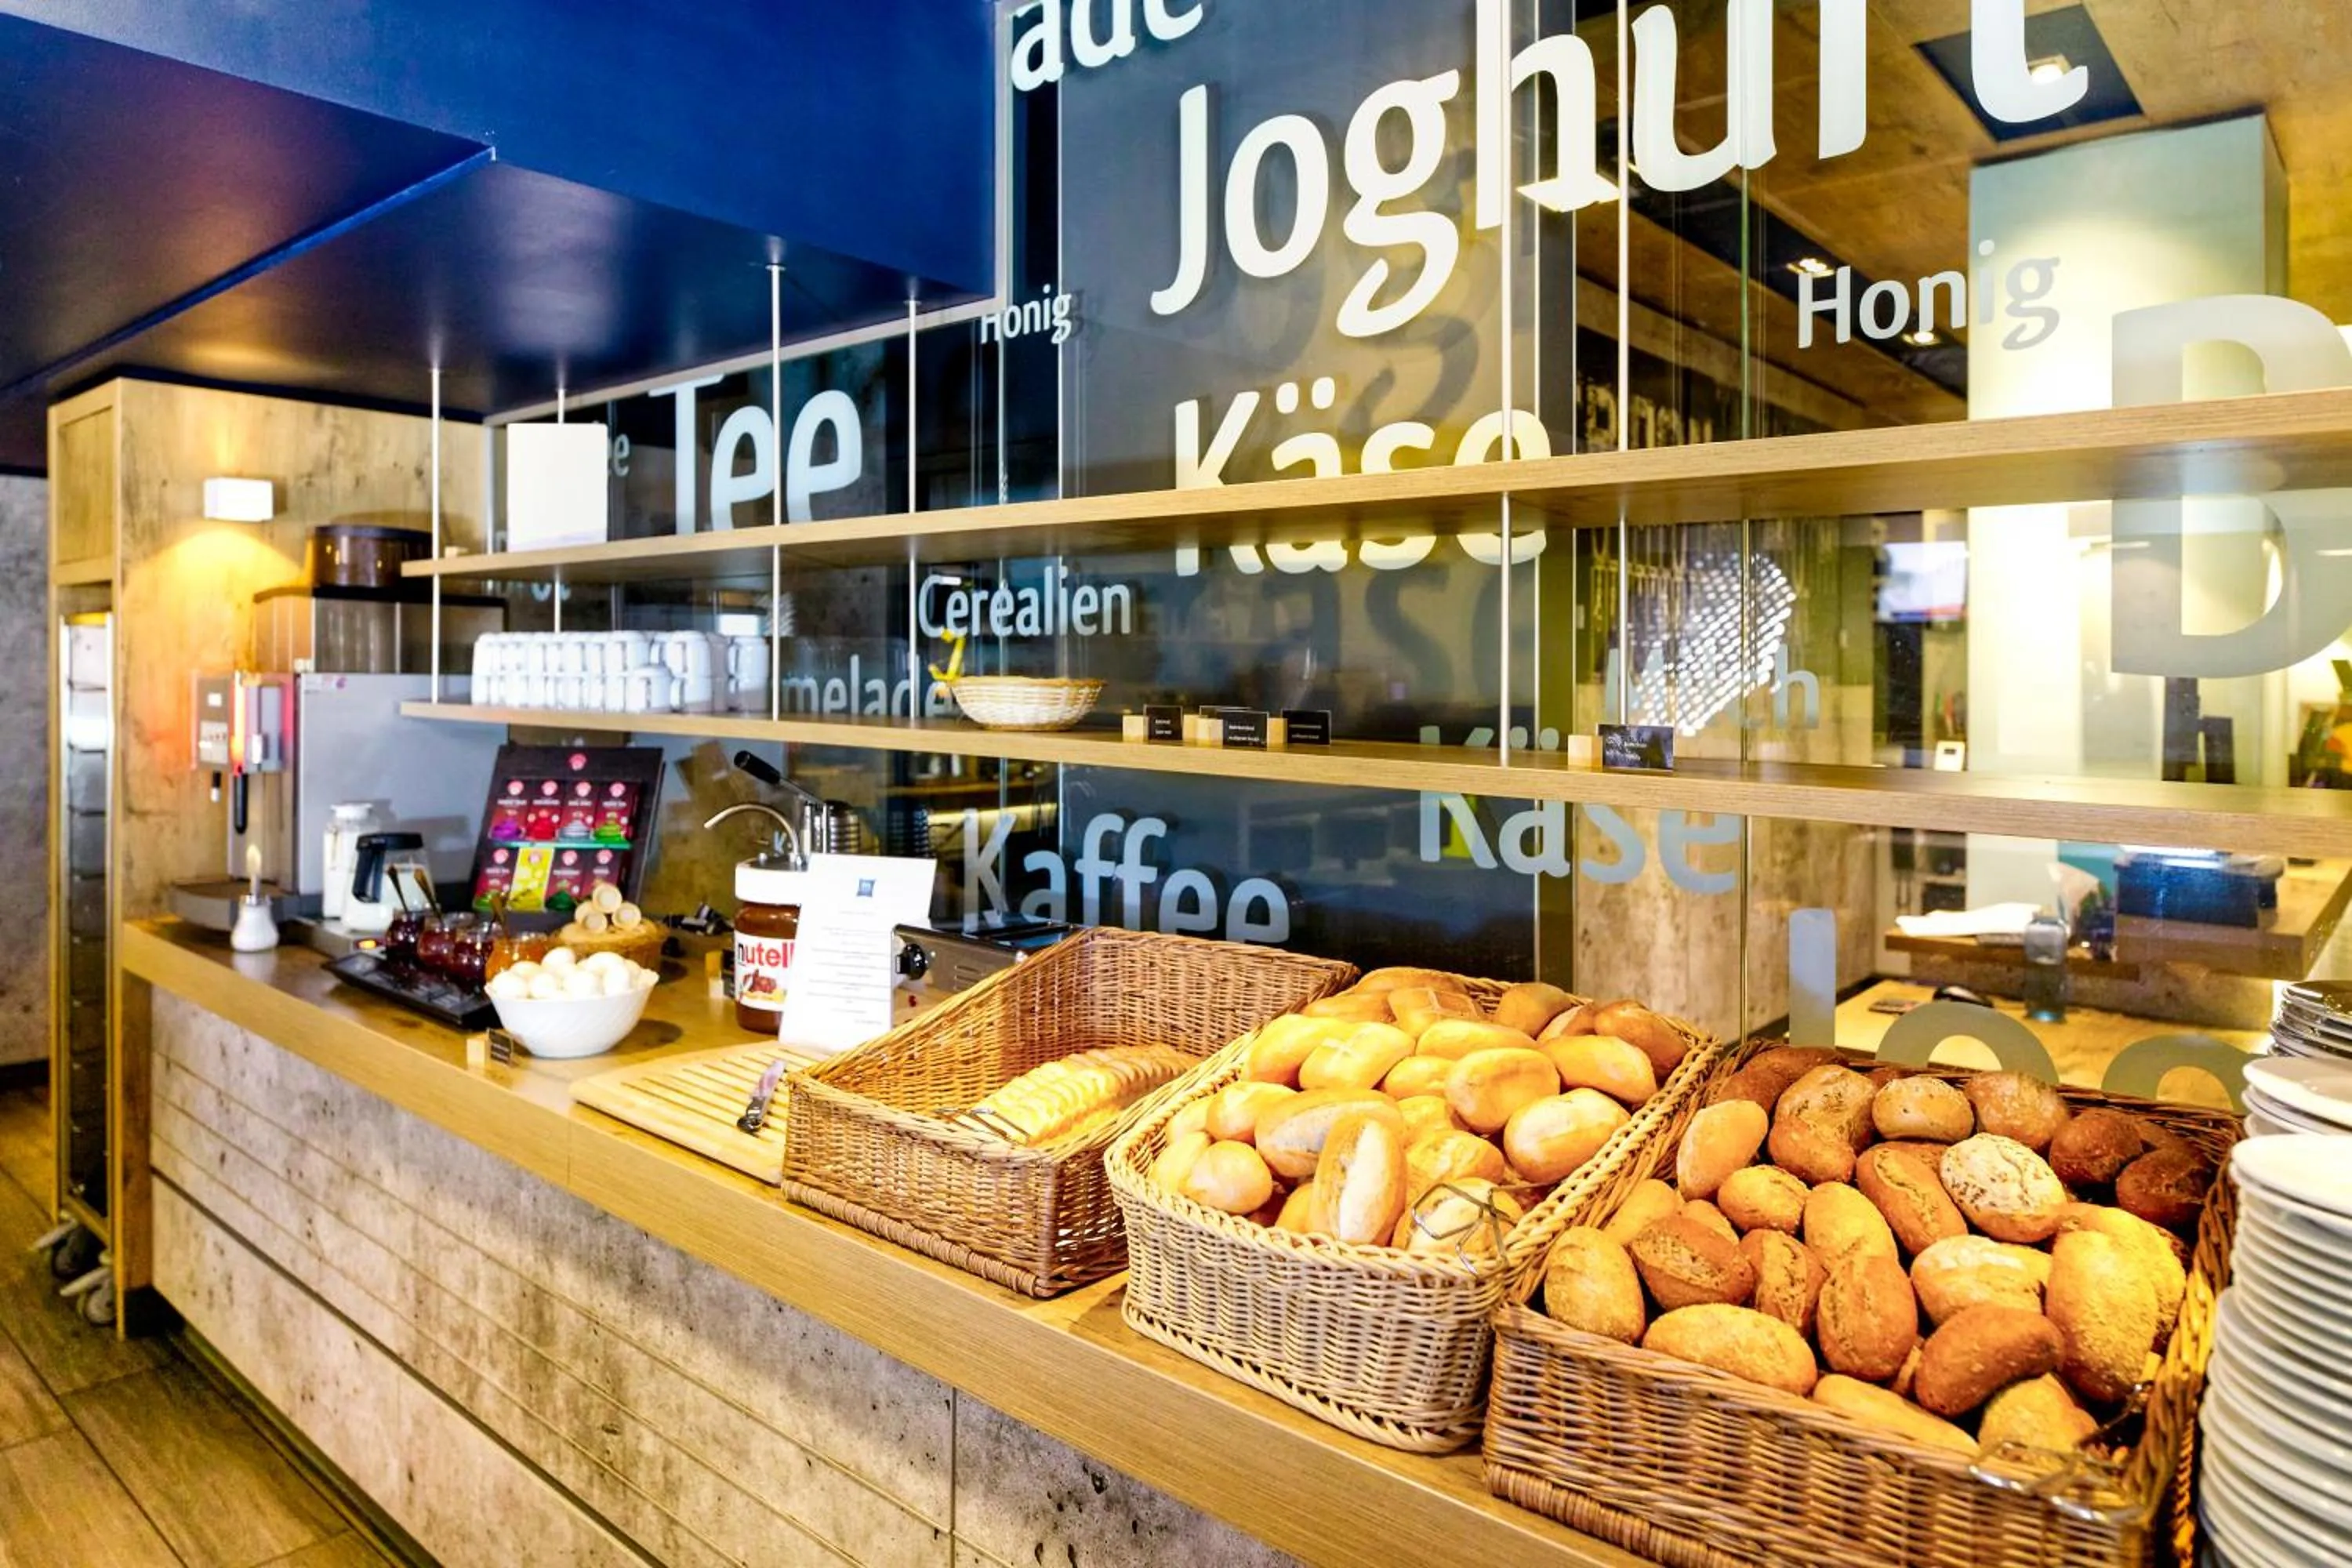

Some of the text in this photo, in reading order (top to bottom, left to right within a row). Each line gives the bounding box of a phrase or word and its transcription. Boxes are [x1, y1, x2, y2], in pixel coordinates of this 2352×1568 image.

[981, 284, 1072, 344] Honig
[1798, 239, 2062, 350] Honig
[649, 374, 862, 535] Tee
[782, 654, 955, 717] melade
[962, 808, 1290, 945] Kaffee
